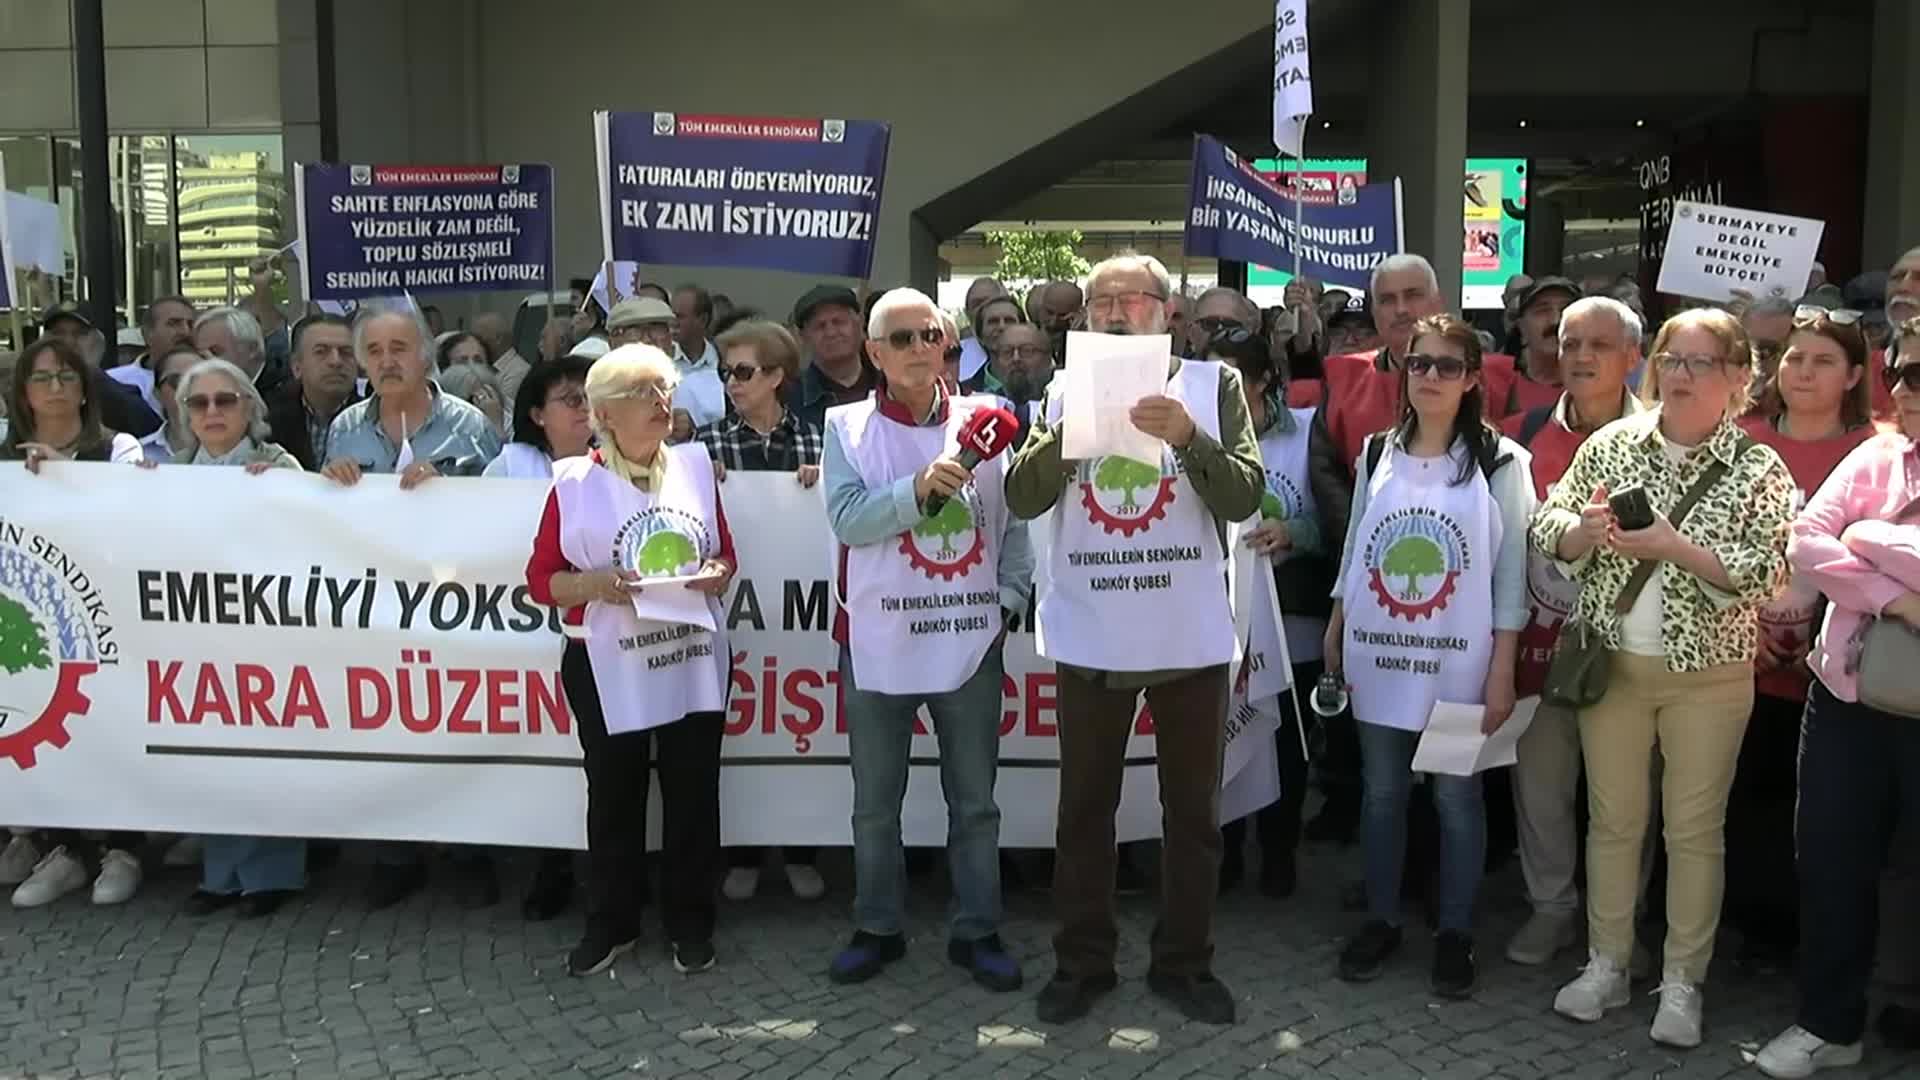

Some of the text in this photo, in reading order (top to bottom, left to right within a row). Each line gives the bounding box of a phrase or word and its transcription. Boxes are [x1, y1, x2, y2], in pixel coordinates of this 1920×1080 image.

[679, 120, 818, 138] TÜM EMEKLİLER SENDİKASI
[375, 170, 499, 184] TÜM EMEKLİLER SENDİKASI
[618, 164, 877, 200] FATURALARI ÖDEYEMİYORUZ,
[1640, 155, 1670, 190] QNB
[331, 190, 538, 213] SAHTE ENFLASYONA GÖRE
[1207, 175, 1276, 222] İNSANCA
[1277, 214, 1297, 235] VE
[1301, 224, 1374, 246] ONURLU
[352, 214, 521, 238] YÜZDELİK ZAM DEĞİL,
[621, 199, 873, 241] EK ZAM İSTİYORUZ!
[1192, 204, 1220, 228] BİR
[1226, 210, 1285, 248] YAŞAM
[1697, 213, 1798, 237] SERMAYEYE
[362, 238, 511, 263] TOPLU SÖZLEŞMELİ
[1718, 232, 1768, 249] DEĞİL
[1695, 246, 1782, 268] EMEKÇİYE
[326, 263, 545, 289] SENDİKA HAKKI İSTİYORUZ!
[1704, 264, 1766, 282] BÜTÇE!
[1147, 544, 1202, 563] SENDİKASI
[1090, 570, 1171, 592] KADIKÖY ŞUBESİ
[28, 534, 119, 665] SENDİKASI
[137, 565, 377, 630] EMEKLİYİ
[881, 595, 900, 612] TÜM
[902, 590, 964, 611] EMEKLİLERİN
[910, 613, 989, 636] KADIKÖY ŞUBESİ
[146, 660, 329, 729] KARA
